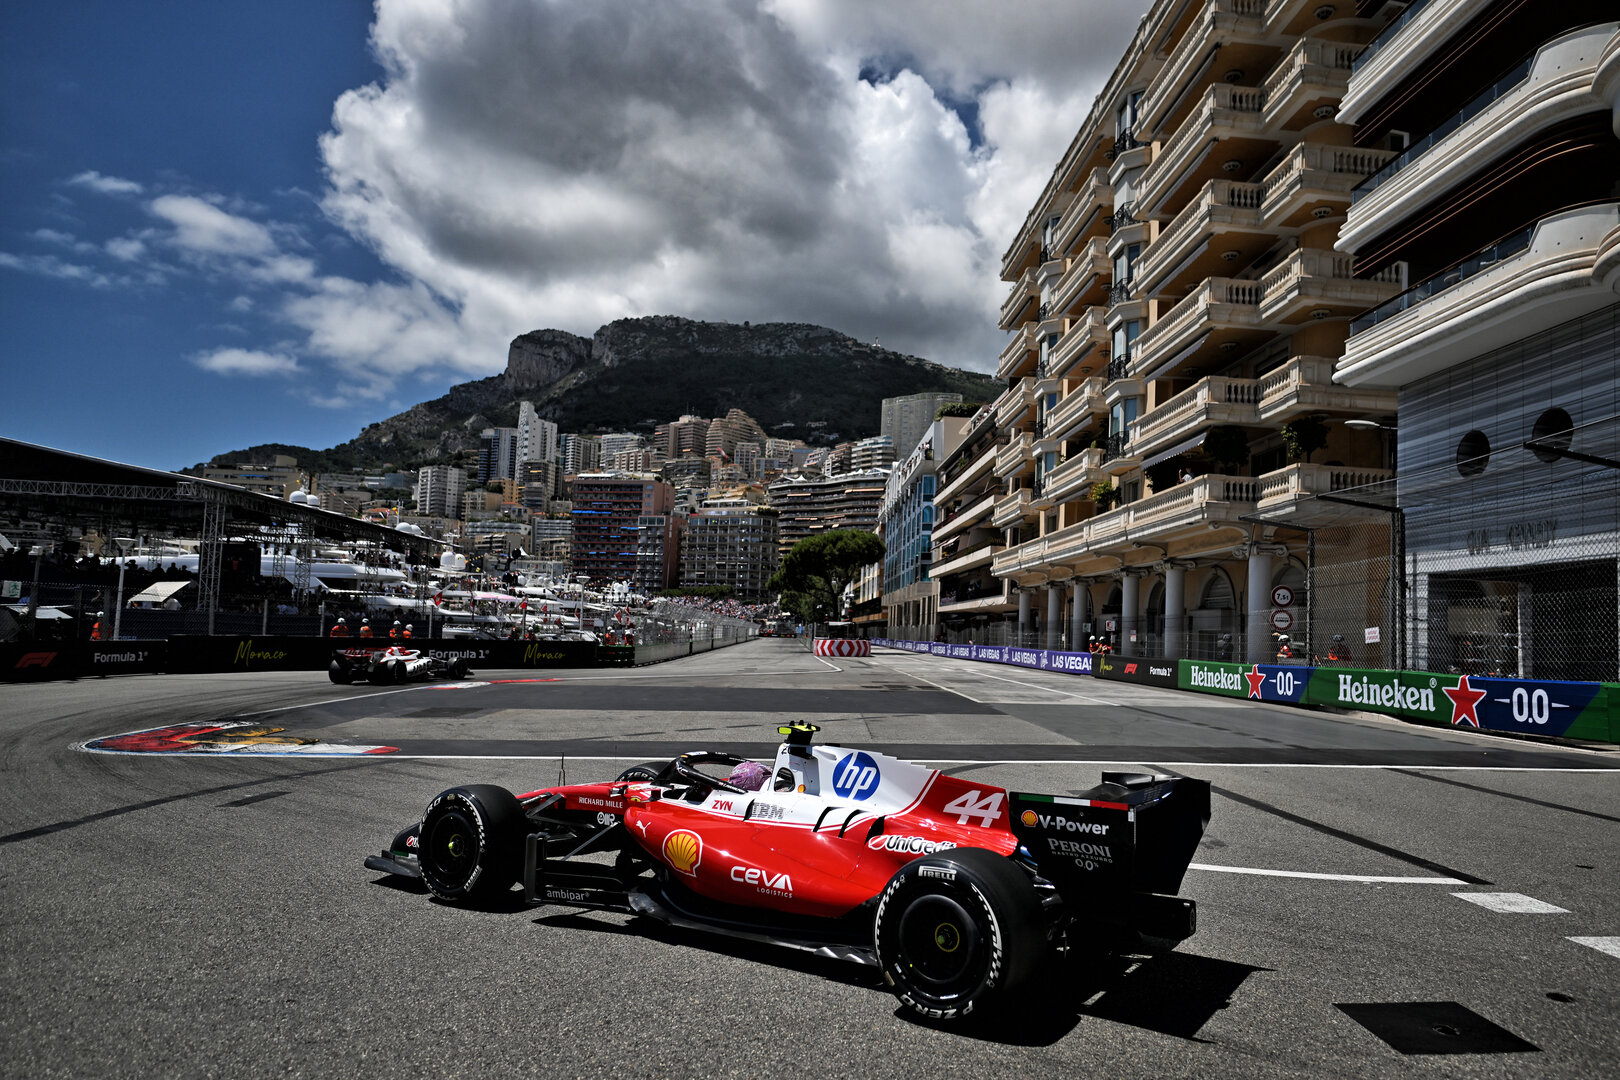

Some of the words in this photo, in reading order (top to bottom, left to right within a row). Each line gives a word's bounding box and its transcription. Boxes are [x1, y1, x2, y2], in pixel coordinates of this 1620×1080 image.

[94, 653, 136, 663] Formula
[234, 640, 287, 667] Monaco
[429, 649, 476, 659] Formula
[524, 643, 565, 664] Monaco
[979, 648, 987, 658] LAS
[987, 649, 1000, 660] VEGAS
[1012, 650, 1022, 662] LAS
[1021, 652, 1037, 665] VEGAS
[1052, 655, 1064, 668] LAS
[1150, 666, 1167, 676] Formula
[1191, 666, 1241, 690] Heineken
[1277, 671, 1294, 696] 0.0
[1338, 674, 1436, 712] Heineken
[1512, 687, 1549, 725] 0.0
[836, 752, 877, 800] hp
[579, 797, 604, 806] RICHARD
[605, 800, 623, 809] MILLE
[712, 800, 733, 811] ZYN
[752, 802, 784, 819] IBM
[943, 790, 1005, 828] 44
[1039, 815, 1109, 835] V-Power
[1048, 838, 1112, 858] PERONI
[918, 865, 957, 881] PIRELLI
[546, 889, 585, 900] ambipar
[757, 887, 793, 898] LOGISTICS
[900, 994, 957, 1019] ZERO
[962, 1000, 973, 1015] P
